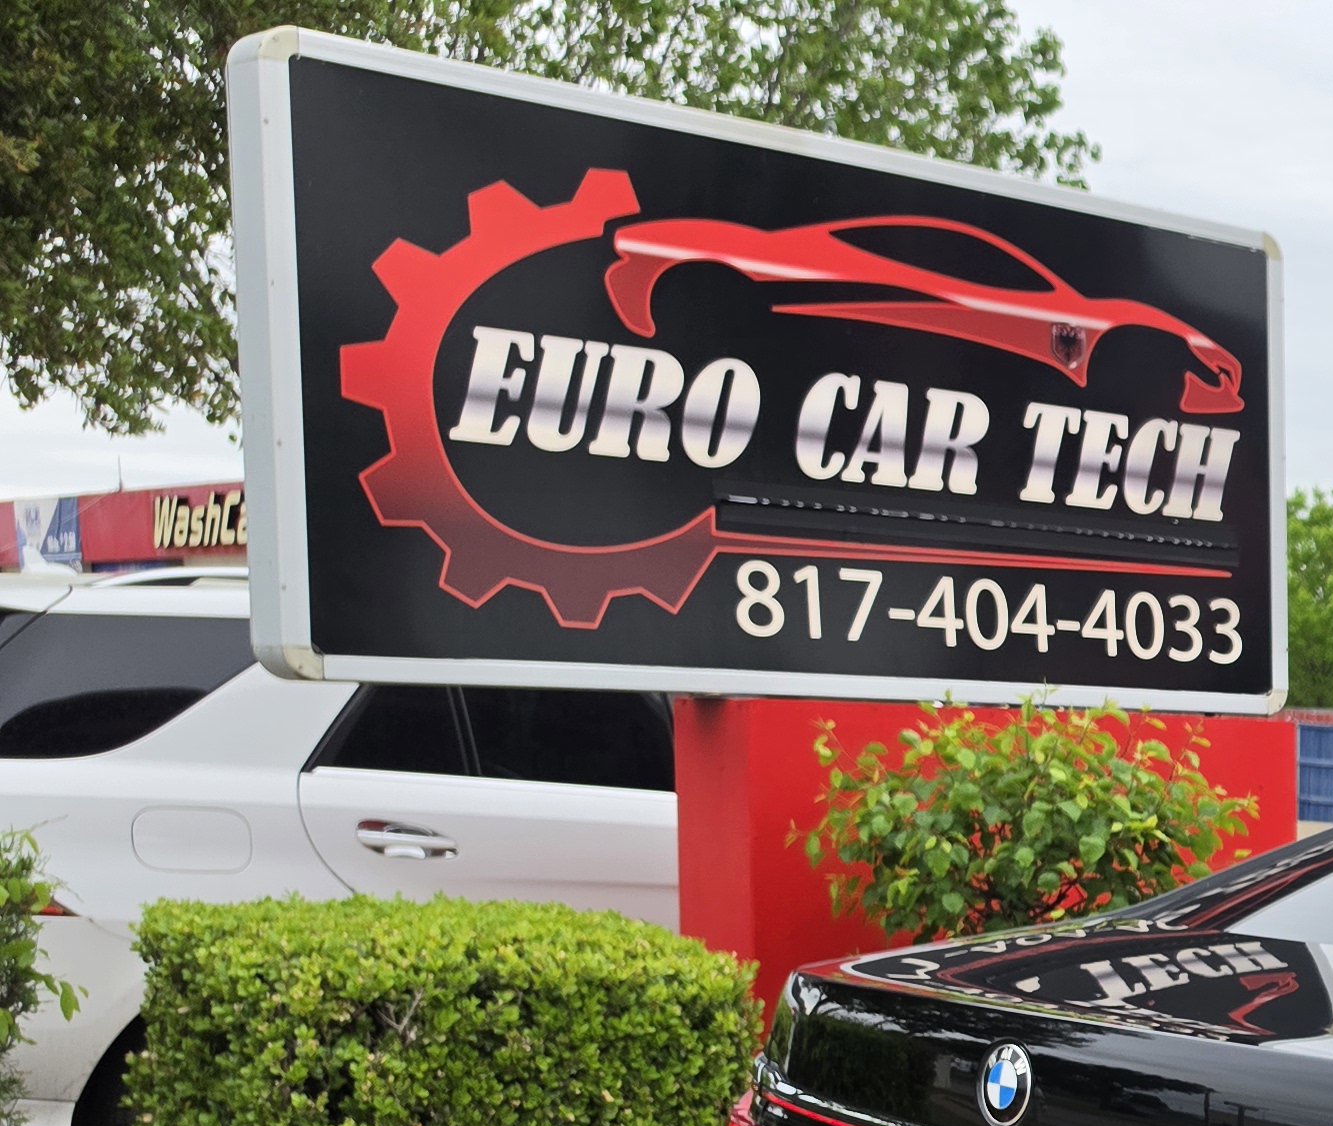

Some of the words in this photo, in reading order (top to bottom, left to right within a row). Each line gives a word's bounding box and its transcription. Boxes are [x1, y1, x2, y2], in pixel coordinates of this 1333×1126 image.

[449, 326, 761, 468] EURO
[795, 372, 990, 494] CAR
[1019, 401, 1240, 521] TECH
[736, 560, 1243, 664] 817-404-4033
[988, 1046, 1027, 1076] BMW
